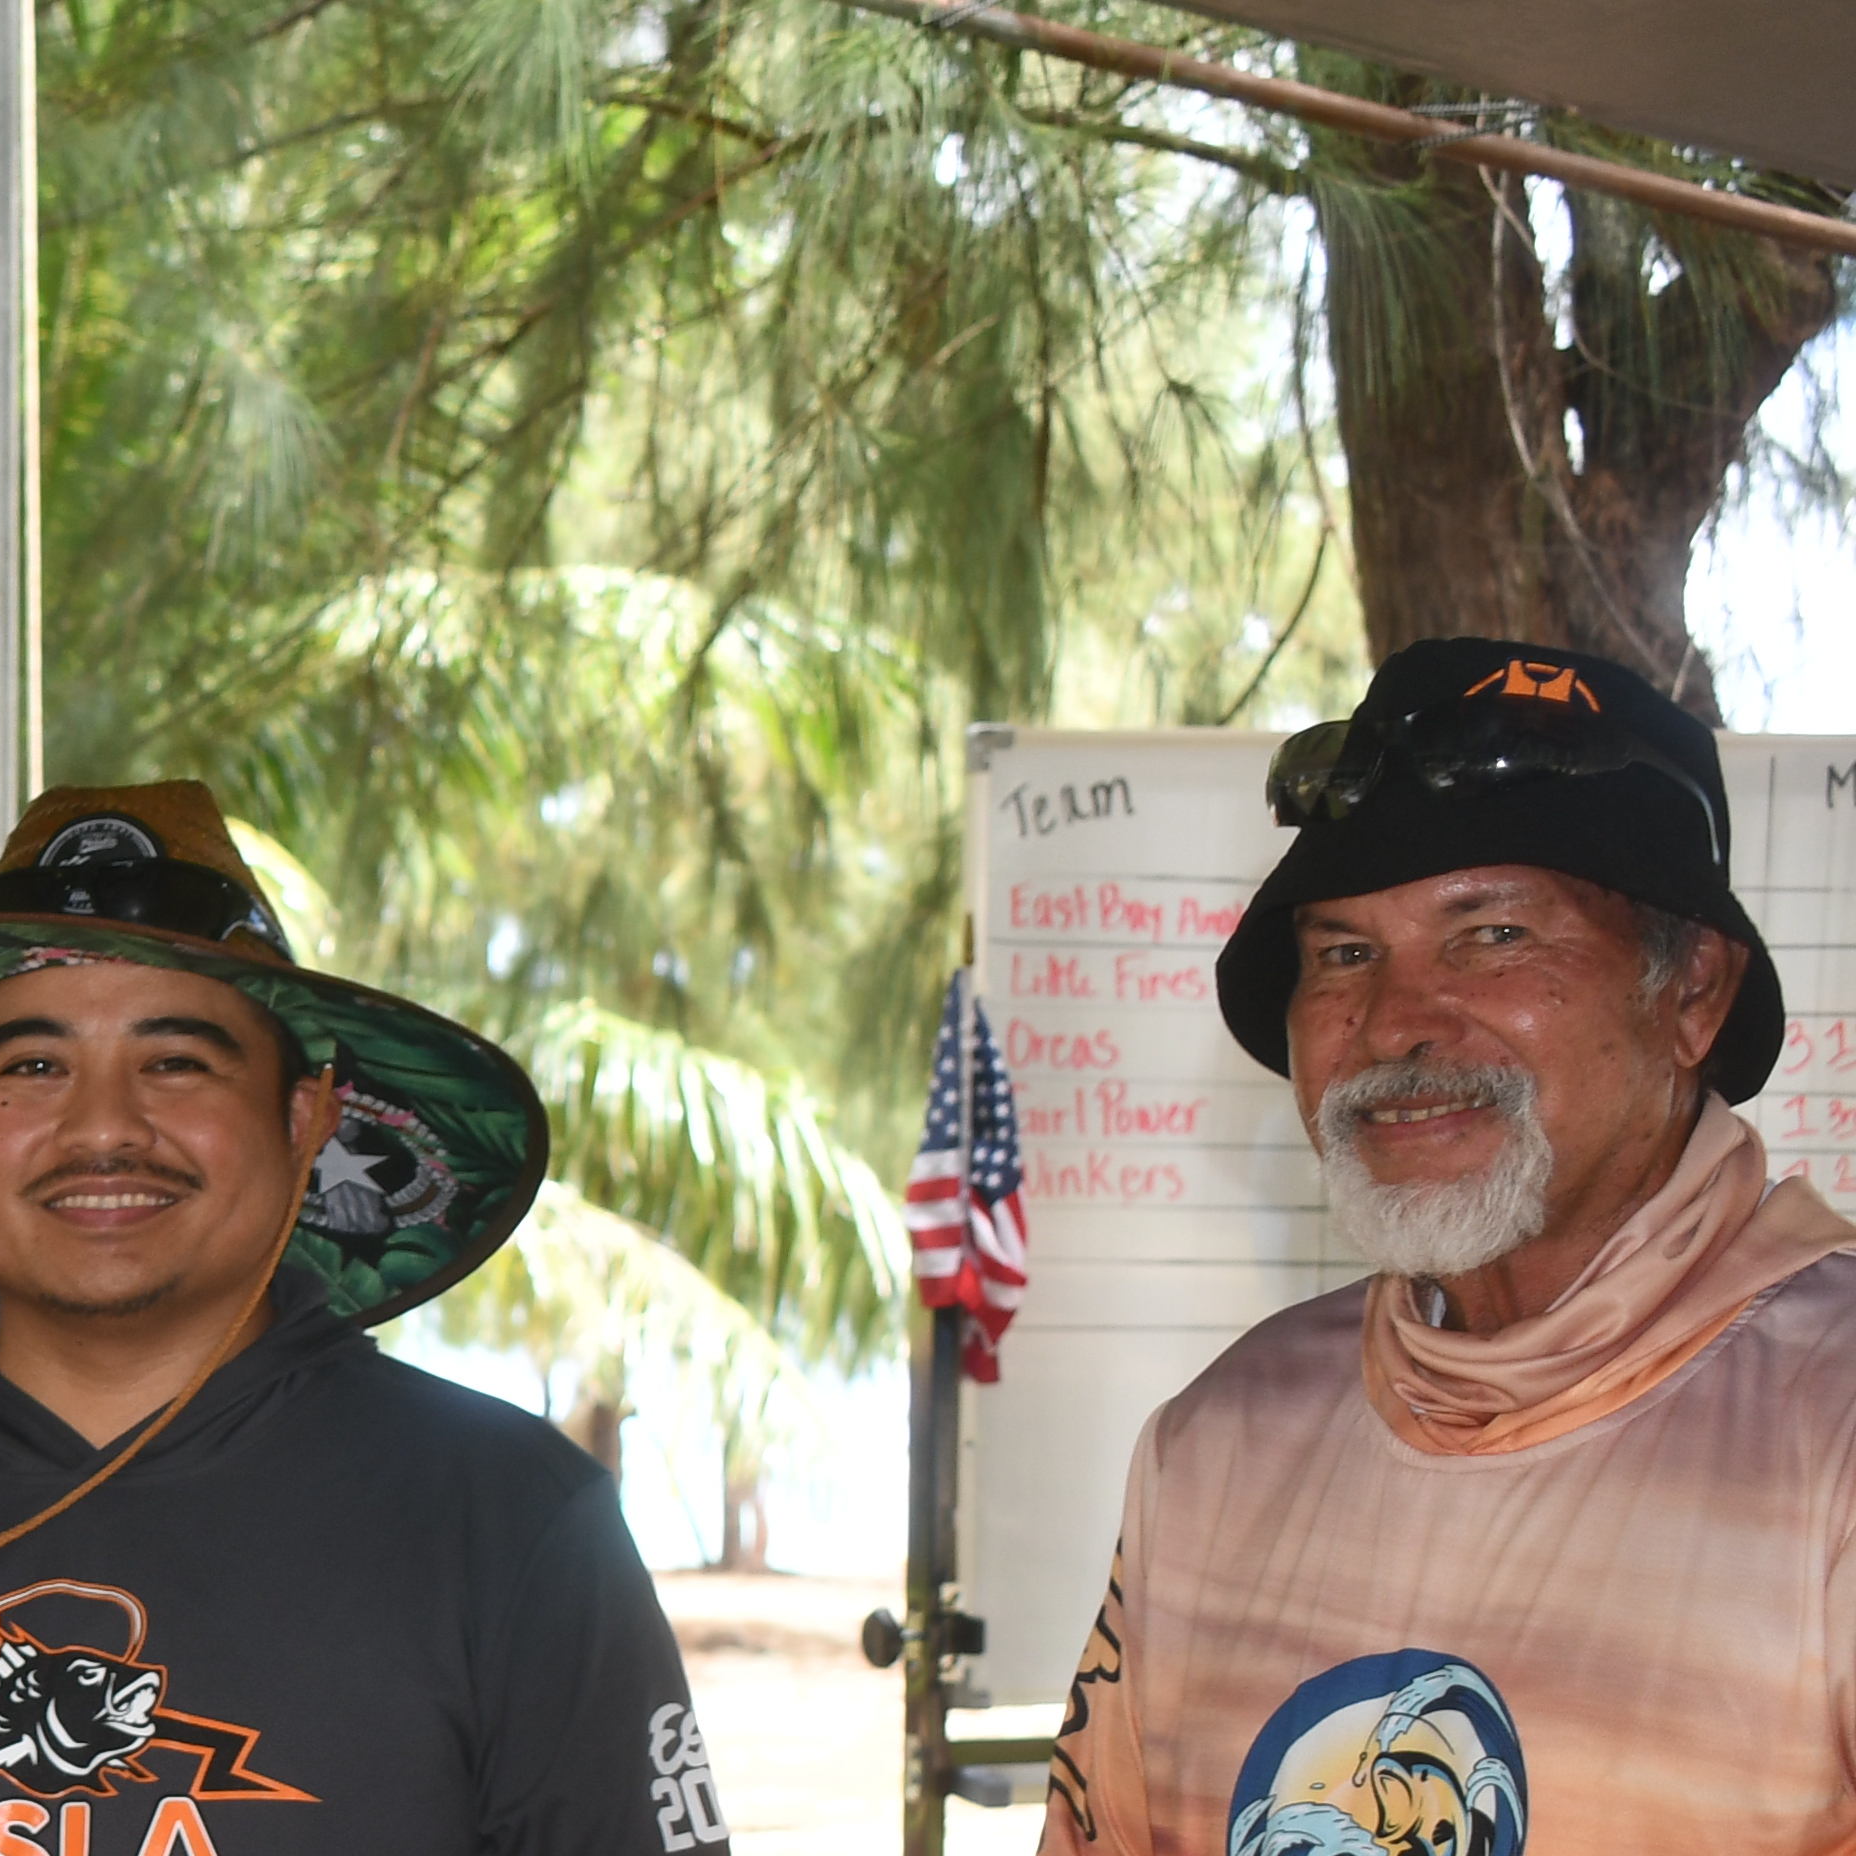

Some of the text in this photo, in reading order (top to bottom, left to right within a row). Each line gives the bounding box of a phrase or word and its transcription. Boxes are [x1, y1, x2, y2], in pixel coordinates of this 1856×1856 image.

[1000, 776, 1135, 838] Team
[1009, 880, 1088, 930] East
[1094, 1076, 1209, 1139] Power
